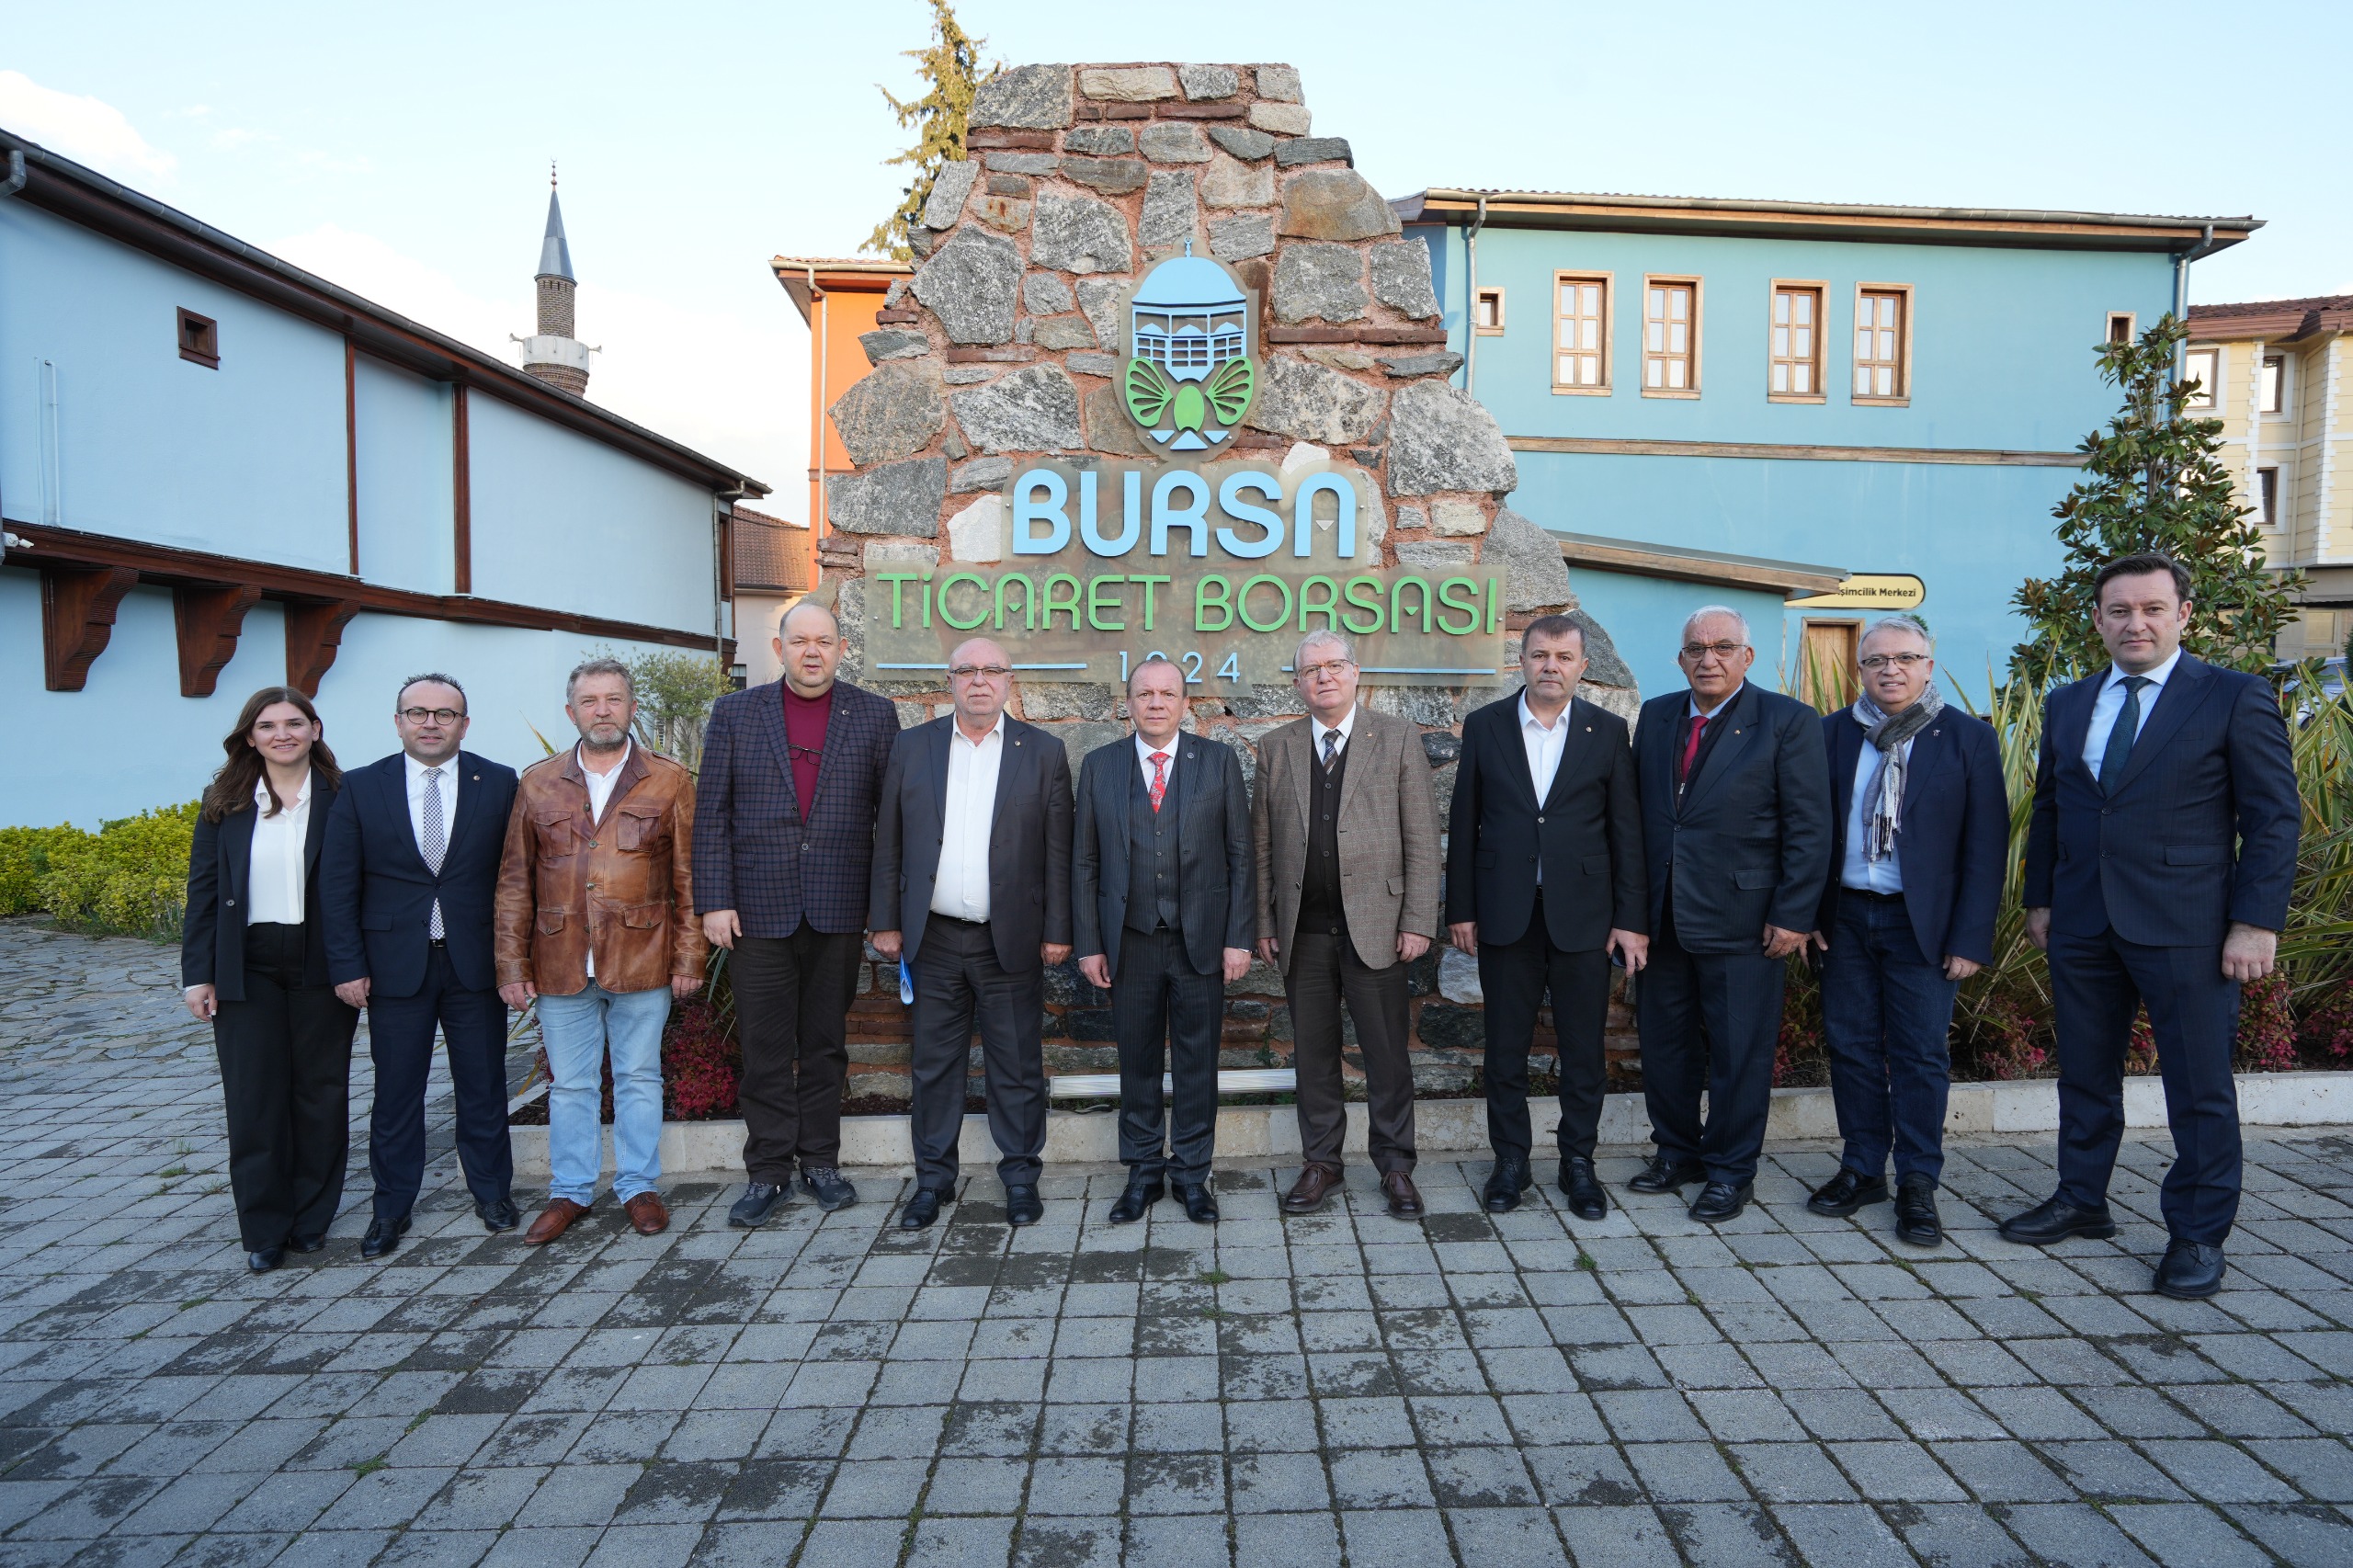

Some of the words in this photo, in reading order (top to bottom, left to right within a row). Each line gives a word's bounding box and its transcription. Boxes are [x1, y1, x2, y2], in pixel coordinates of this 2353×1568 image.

[1012, 469, 1356, 558] BURSA
[1195, 574, 1497, 635] BORSASI
[1838, 586, 1877, 597] şimcilik
[1879, 587, 1916, 597] Merkezi
